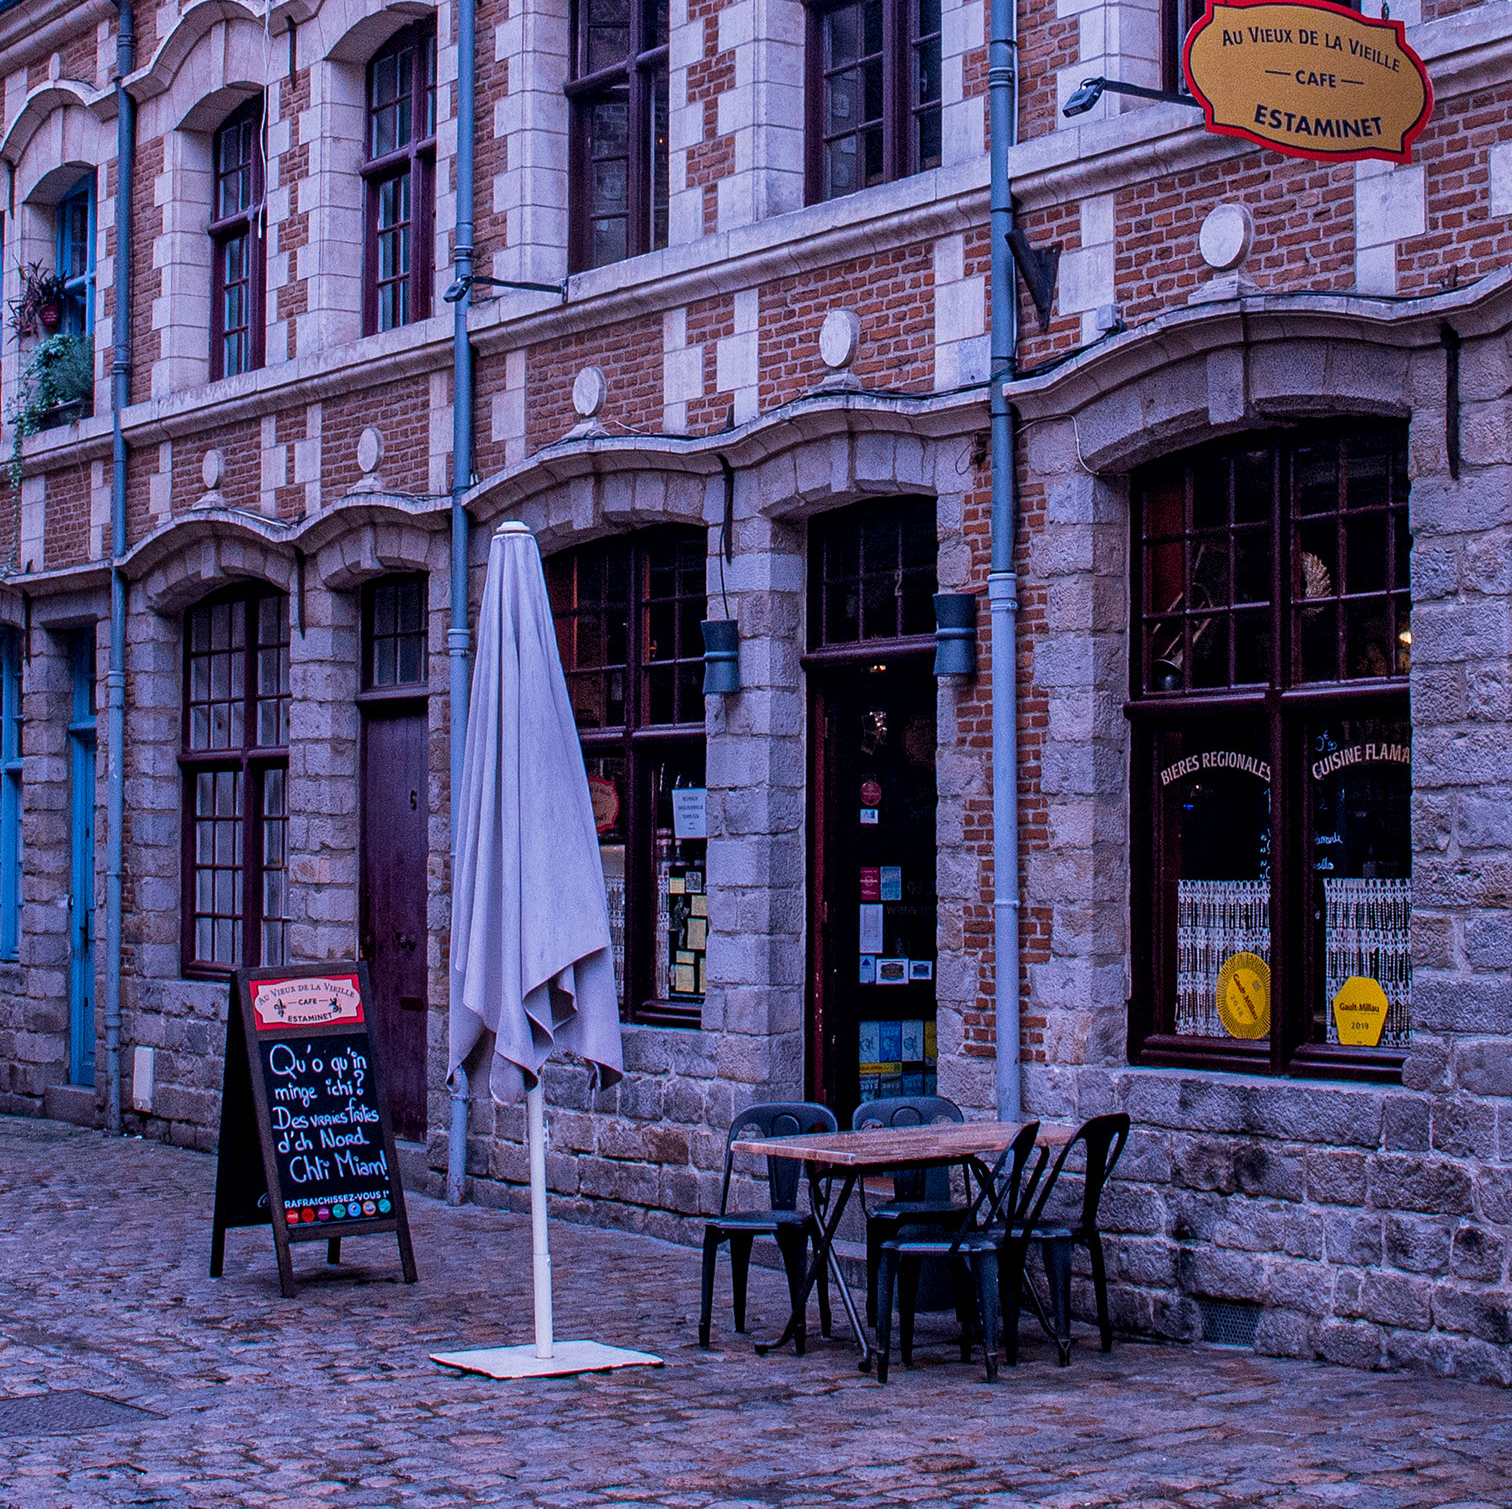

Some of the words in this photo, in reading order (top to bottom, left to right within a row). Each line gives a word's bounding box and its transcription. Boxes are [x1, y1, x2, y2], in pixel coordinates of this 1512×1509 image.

[1248, 25, 1292, 45] VIEUX
[1298, 28, 1318, 46] DE
[1325, 32, 1343, 53] LA
[1348, 37, 1400, 74] VIEILLE
[1295, 69, 1337, 89] CAFE
[1253, 105, 1383, 139] ESTAMINET
[1160, 754, 1200, 786] BIERES
[1202, 751, 1271, 783] REGIONALES
[1312, 745, 1363, 780] CUISINE
[288, 1012, 333, 1023] ESTAMINET
[1359, 1002, 1380, 1012] Millau
[274, 1082, 318, 1108] minge
[272, 1105, 309, 1129] Des
